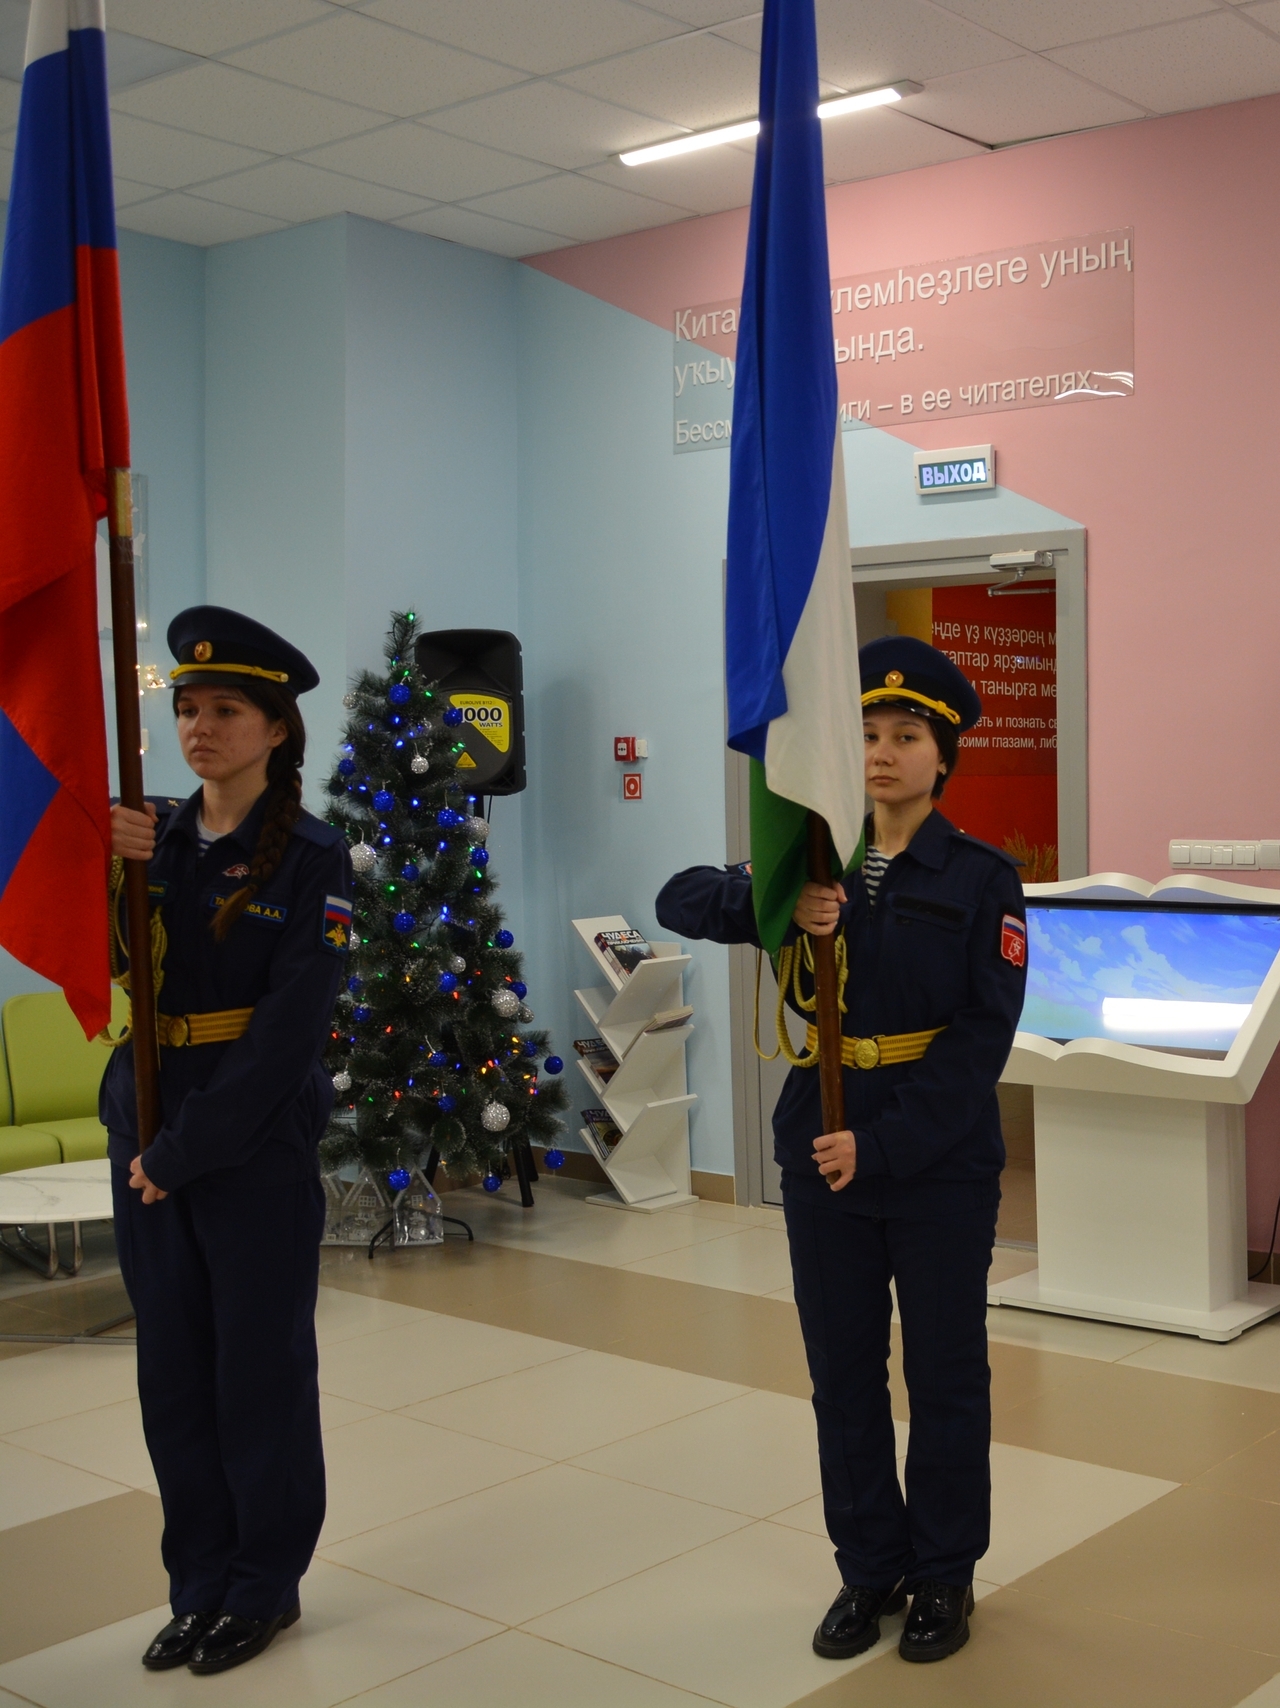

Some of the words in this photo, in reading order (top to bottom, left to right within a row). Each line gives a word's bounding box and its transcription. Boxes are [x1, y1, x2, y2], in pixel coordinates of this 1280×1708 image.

[674, 307, 742, 343] Кита
[900, 391, 914, 415] в
[921, 388, 952, 412] ее
[922, 460, 987, 487] ВЫХОД
[1005, 717, 1047, 730] познать
[991, 736, 1037, 751] глазами,
[263, 907, 283, 920] А.А.
[601, 930, 641, 941] ЧУДЕСА
